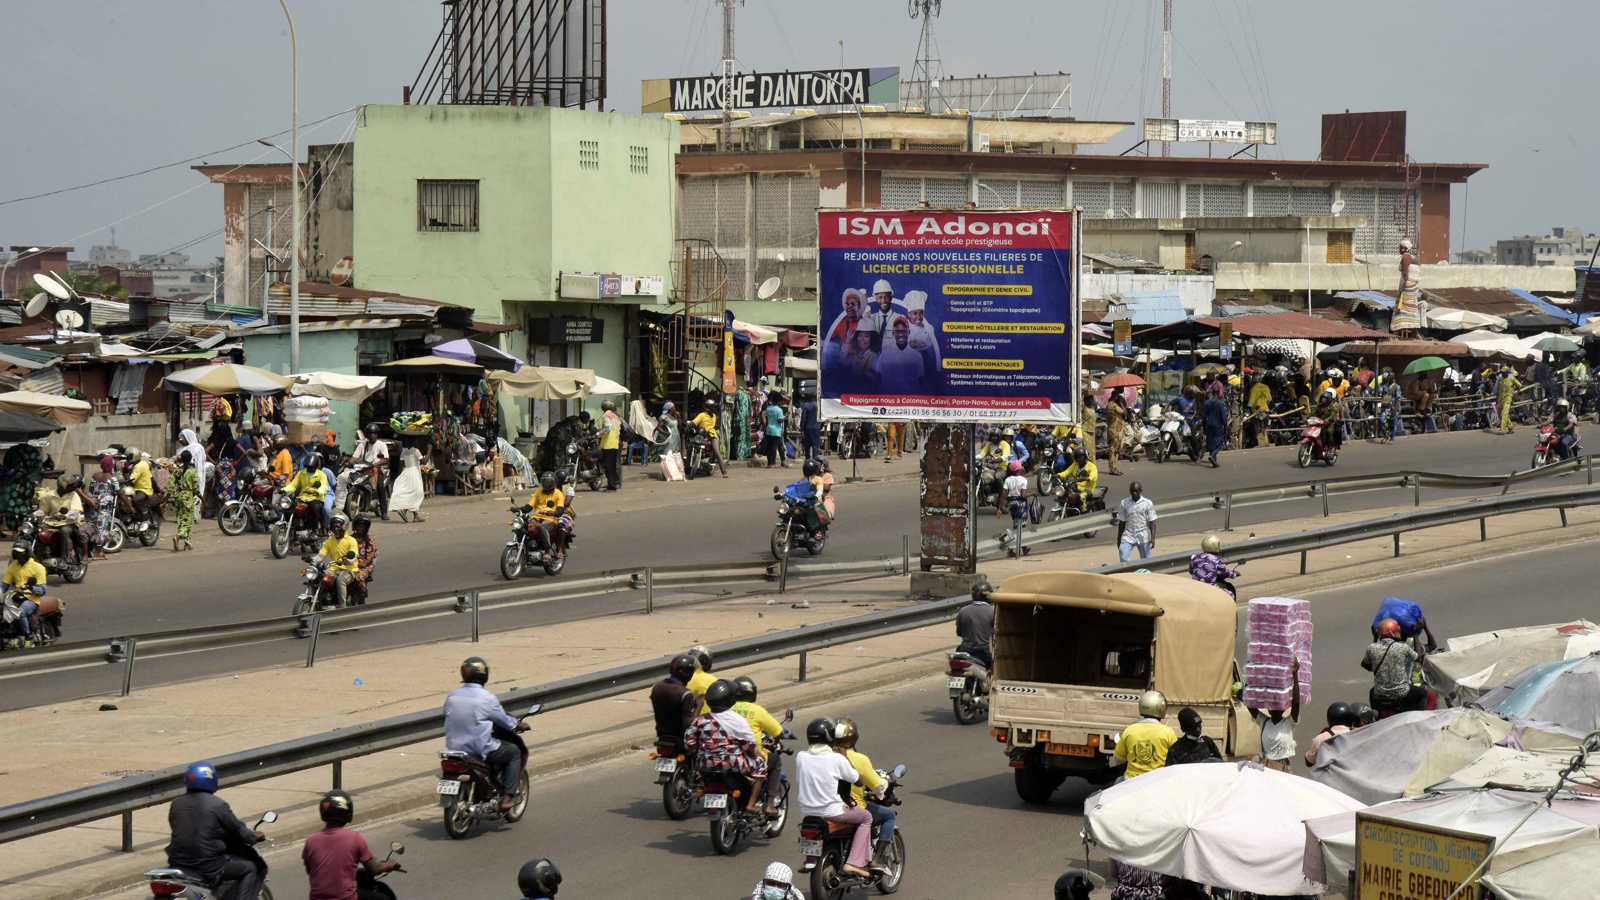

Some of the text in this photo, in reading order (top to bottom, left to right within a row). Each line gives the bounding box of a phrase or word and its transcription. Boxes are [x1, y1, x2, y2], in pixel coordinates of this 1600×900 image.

[760, 71, 864, 106] DANTOKPA
[838, 216, 1052, 236] ISM Adonaï
[878, 237, 1013, 248] la marque d'une école prestigieuse
[844, 252, 1043, 262] REJOINDRE NOS NOUVELLES FILIERES DE
[863, 264, 1024, 274] LICENCE PROFESSIONNELLE
[1363, 862, 1402, 891] MAIRIE
